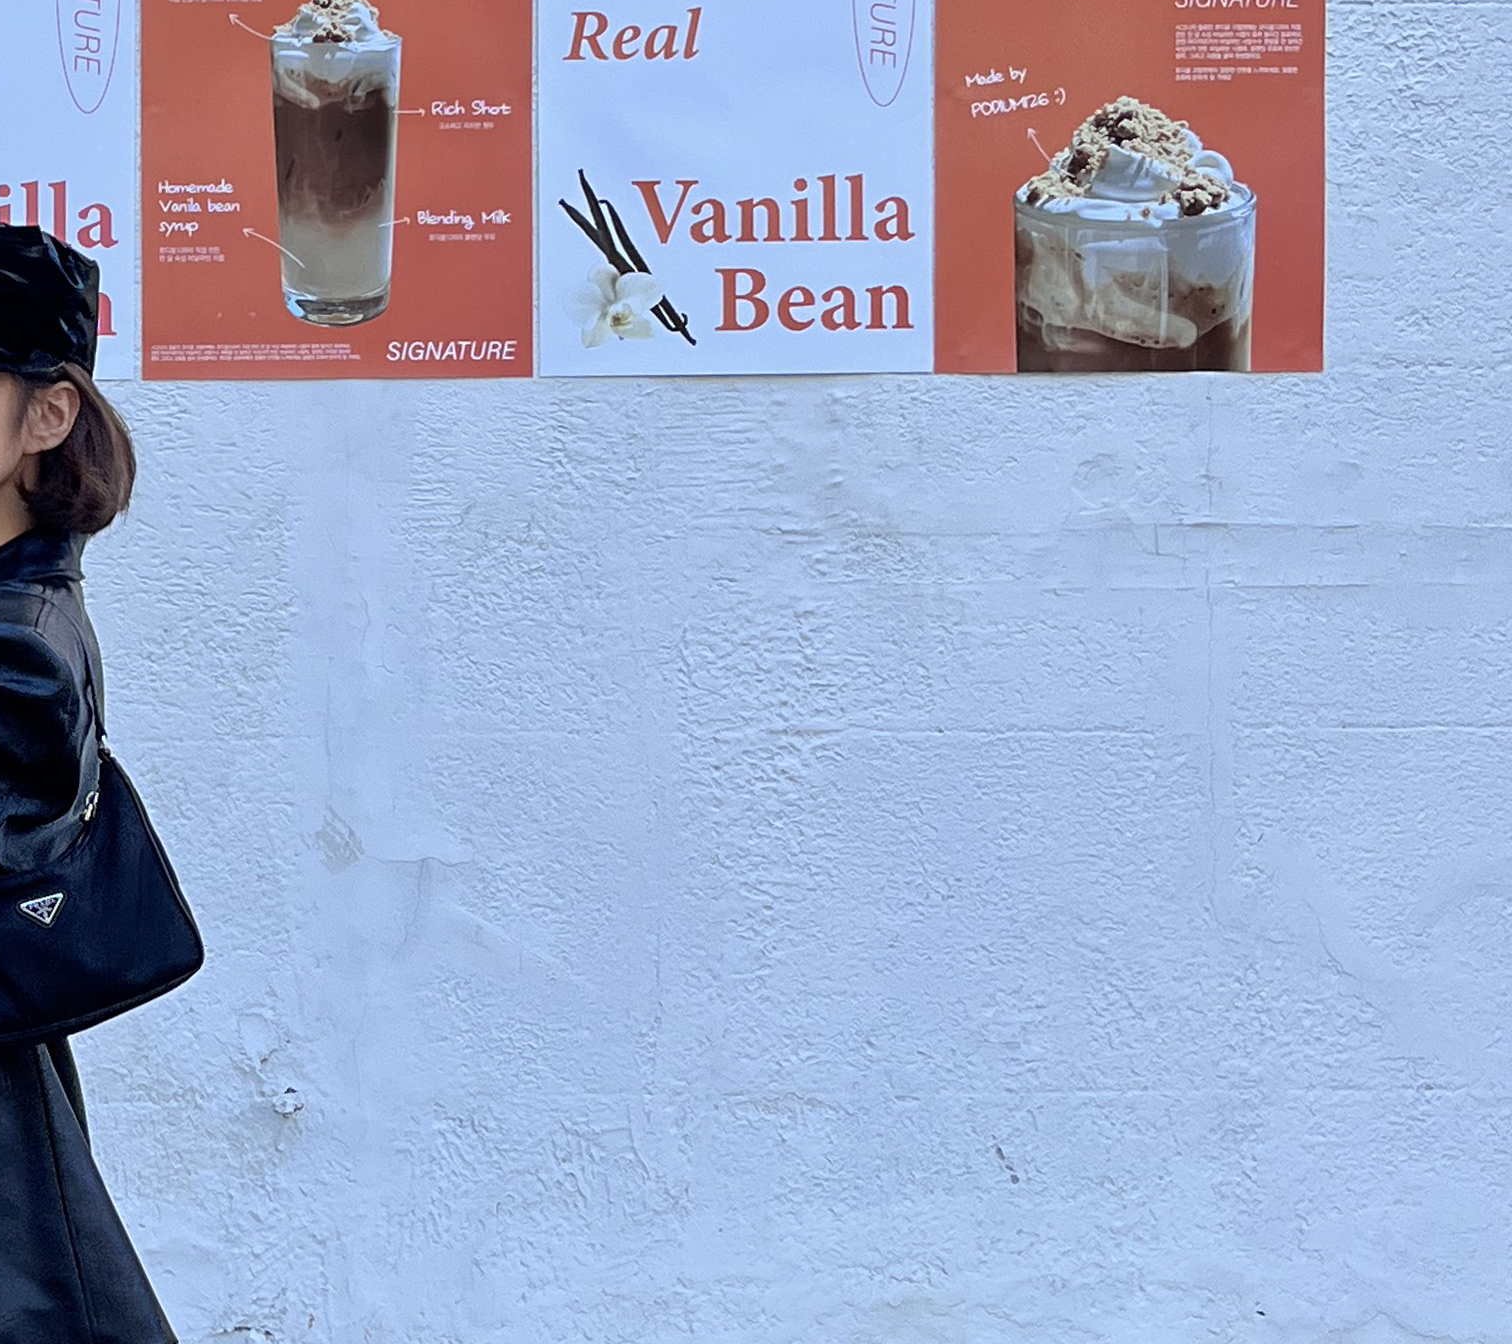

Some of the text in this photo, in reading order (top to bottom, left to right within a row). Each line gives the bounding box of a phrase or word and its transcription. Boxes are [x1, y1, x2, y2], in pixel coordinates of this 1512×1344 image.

[563, 7, 701, 60] Real
[965, 67, 1026, 87] Made by
[432, 100, 511, 115] Rich Shot
[159, 179, 233, 193] Homemade
[208, 199, 240, 212] bean
[632, 173, 915, 244] Vanilla
[160, 222, 198, 236] syrup
[418, 210, 510, 230] Blending Milk
[715, 269, 914, 331] Bean
[387, 341, 517, 360] SIGNATURE
